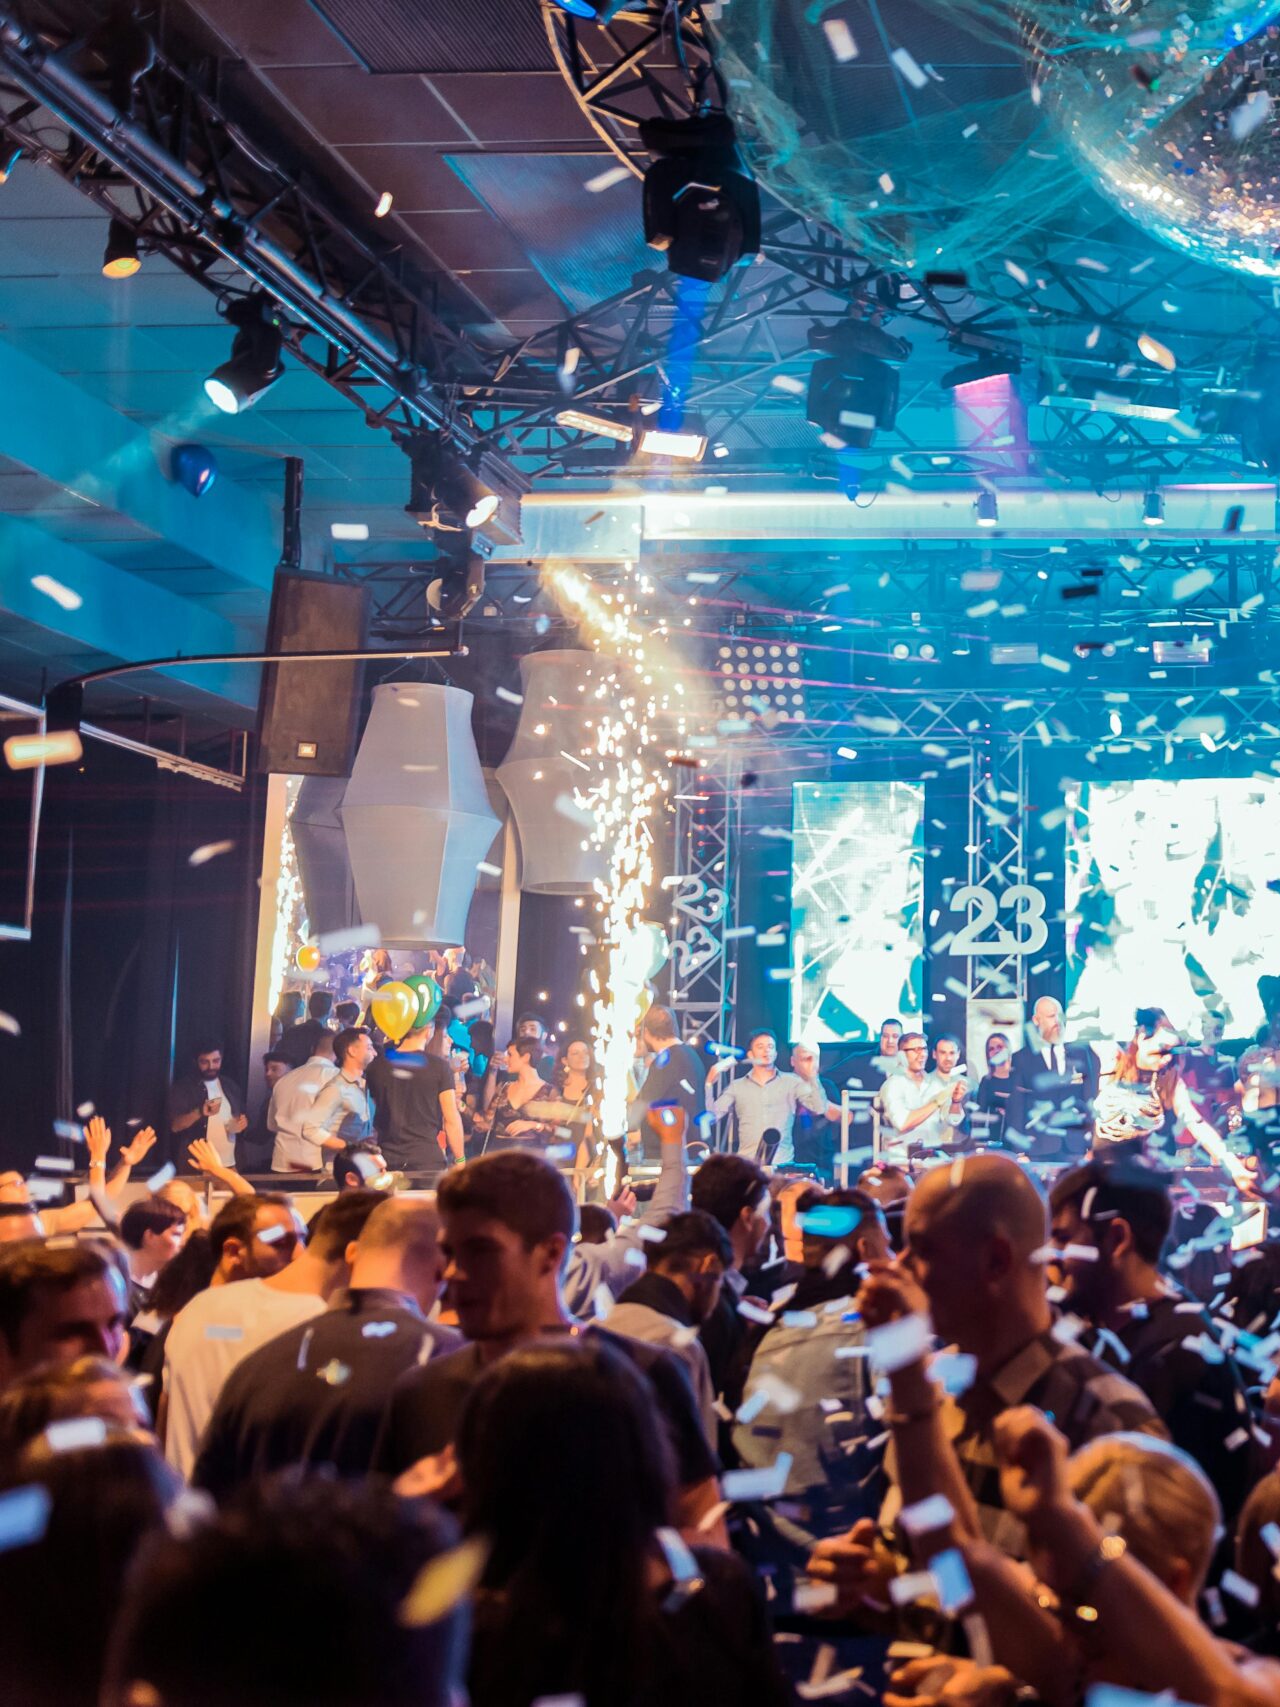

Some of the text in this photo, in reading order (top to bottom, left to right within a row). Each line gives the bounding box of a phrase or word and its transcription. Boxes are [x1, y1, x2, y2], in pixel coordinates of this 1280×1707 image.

[671, 875, 729, 923] 23
[949, 884, 1049, 956] 23
[668, 925, 722, 978] 23
